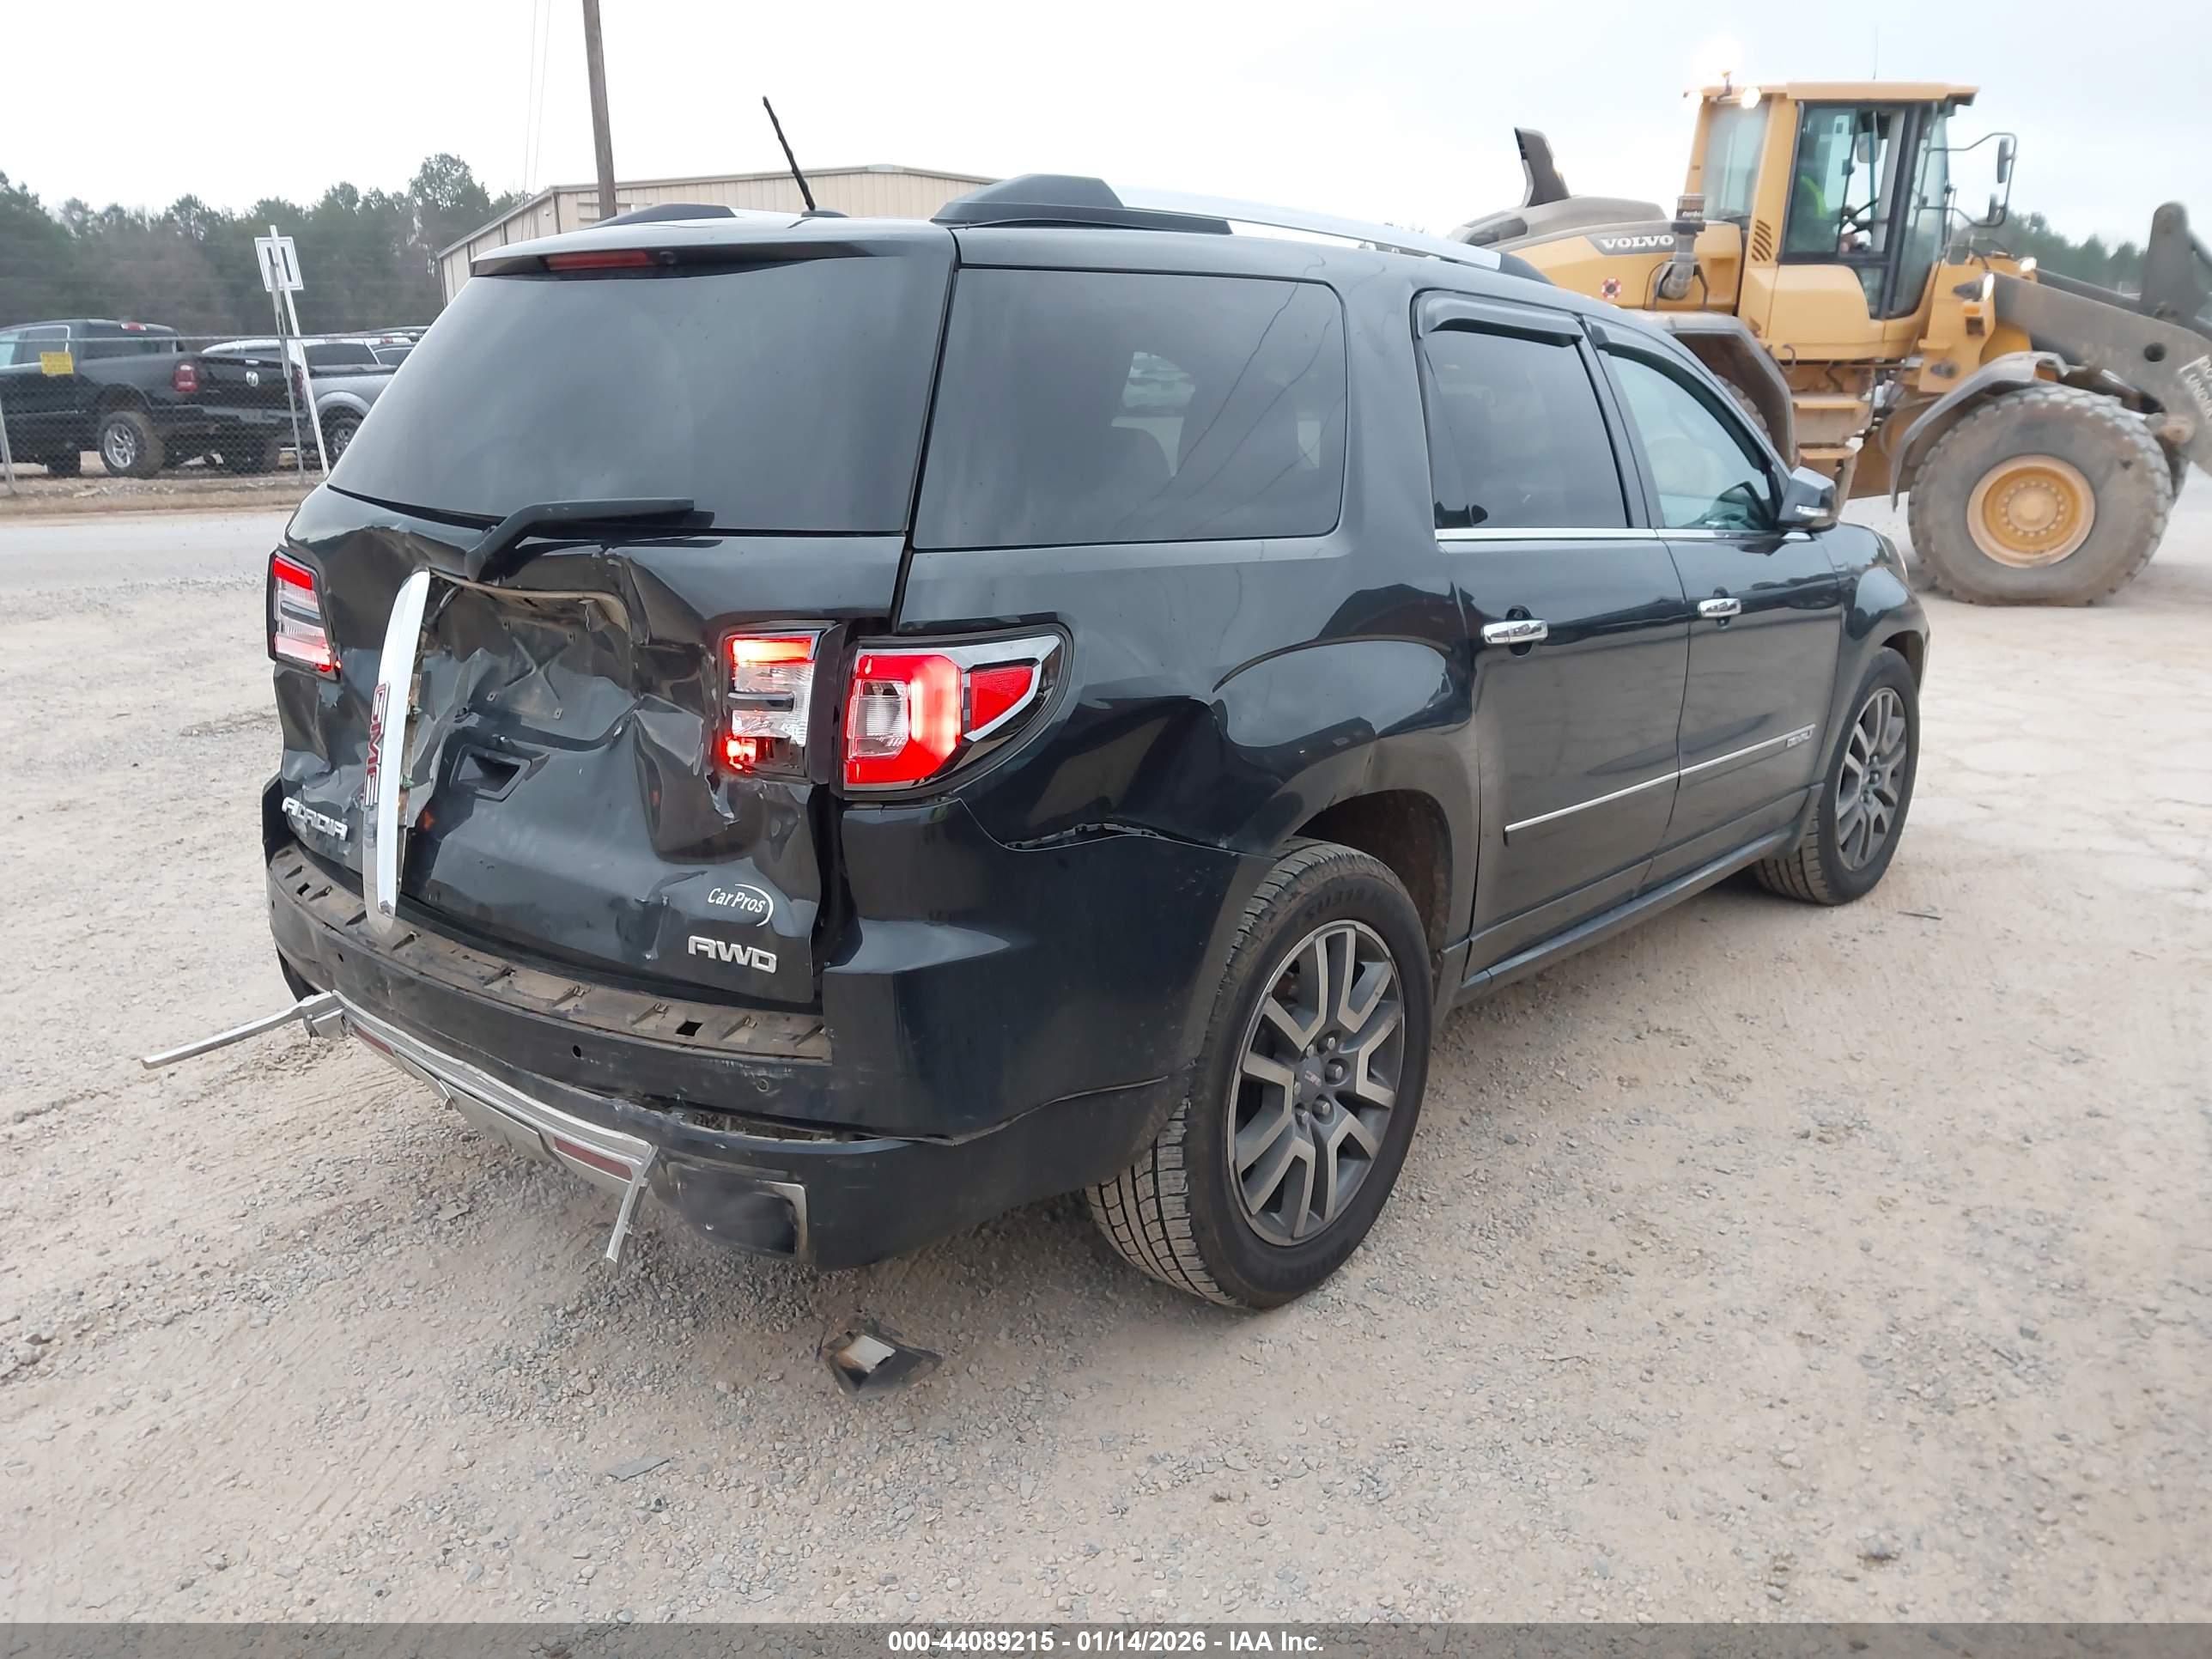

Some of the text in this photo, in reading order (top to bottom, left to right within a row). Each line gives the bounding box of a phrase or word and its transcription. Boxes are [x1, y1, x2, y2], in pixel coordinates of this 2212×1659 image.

[1600, 234, 1674, 250] VOLVO
[362, 682, 391, 807] GMC
[281, 796, 349, 841] ACADIA
[688, 935, 777, 974] AWD
